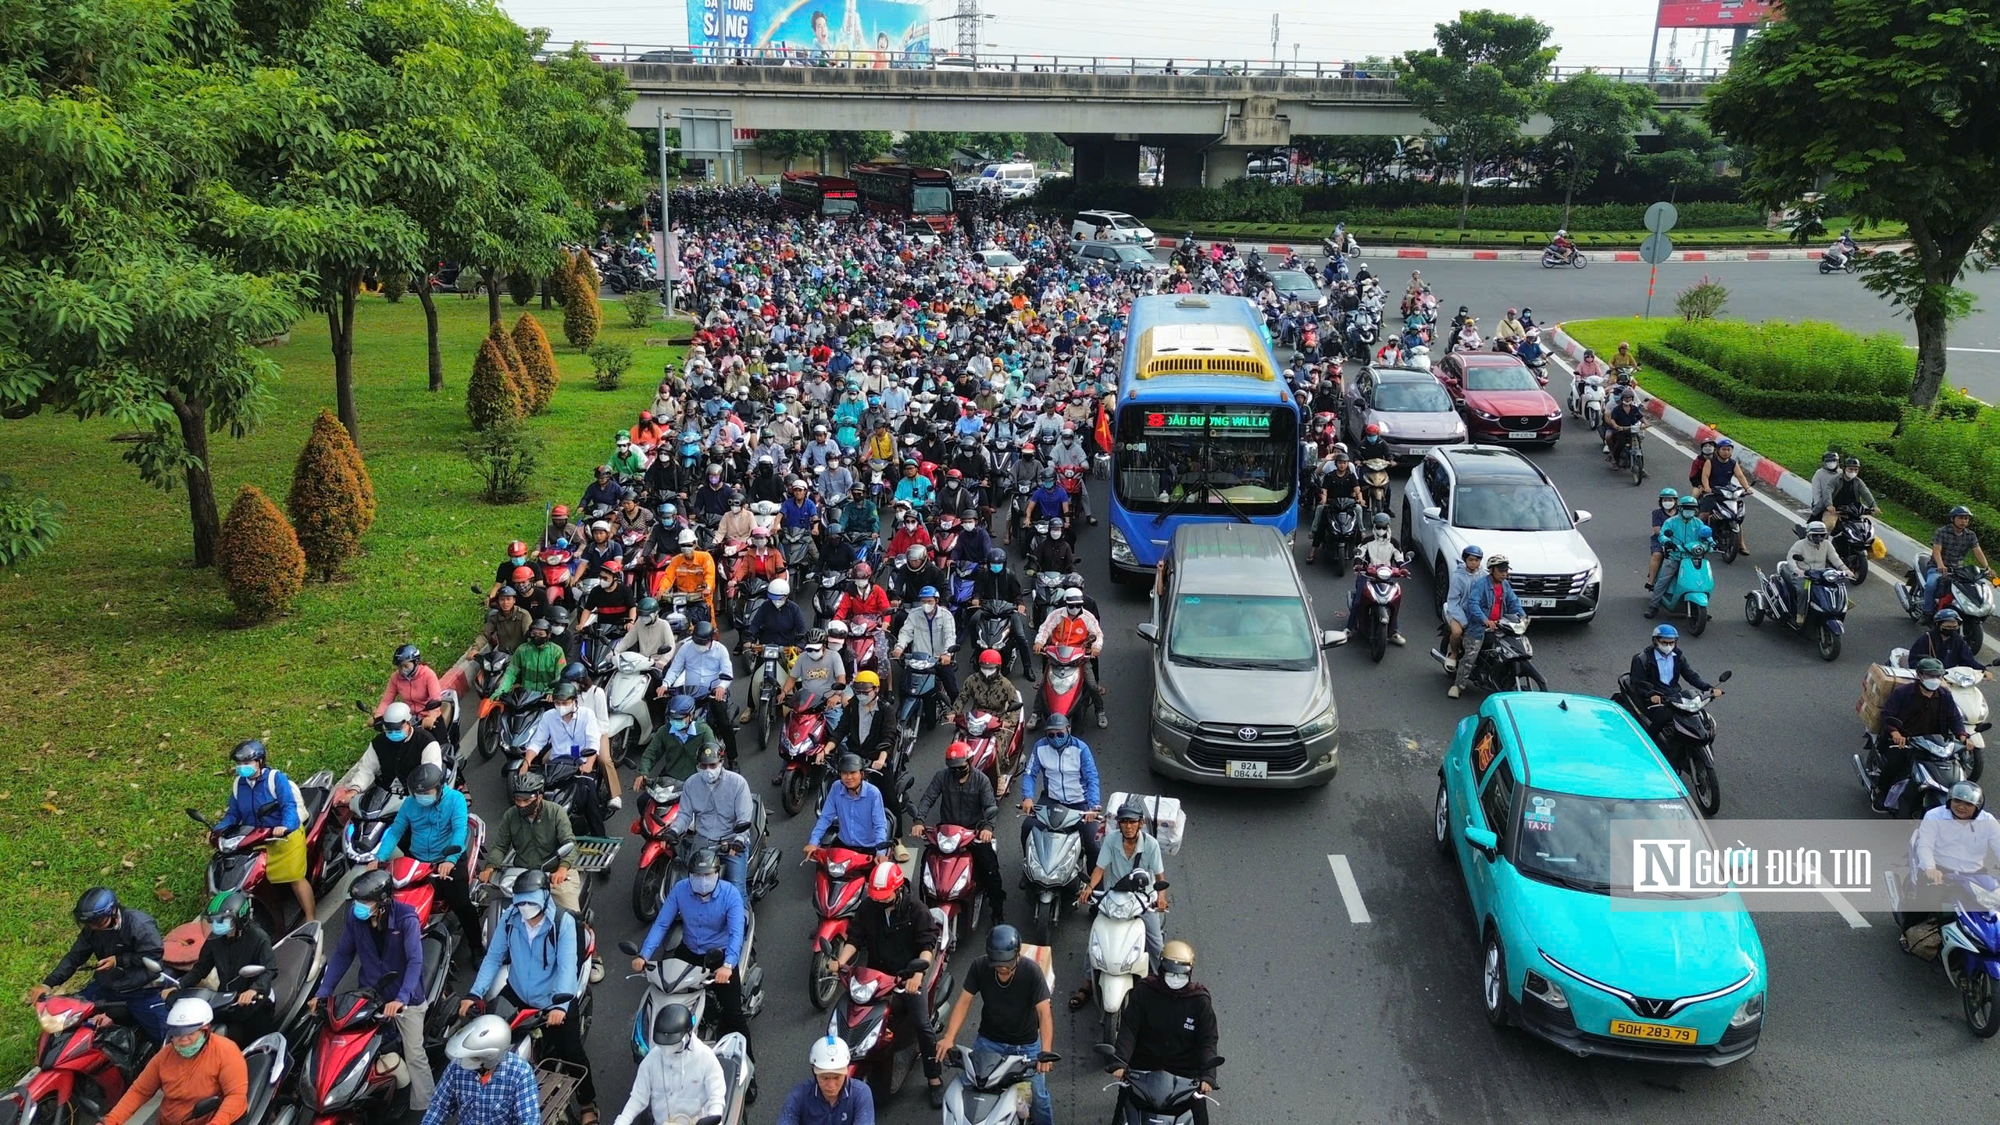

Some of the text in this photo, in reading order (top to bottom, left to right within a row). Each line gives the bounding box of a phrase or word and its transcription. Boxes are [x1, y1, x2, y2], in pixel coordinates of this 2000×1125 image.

[1240, 762, 1257, 770] 82A
[1234, 770, 1263, 778] 084.44
[1527, 821, 1552, 831] TAXI
[1617, 1023, 1690, 1041] 50H-283.79
